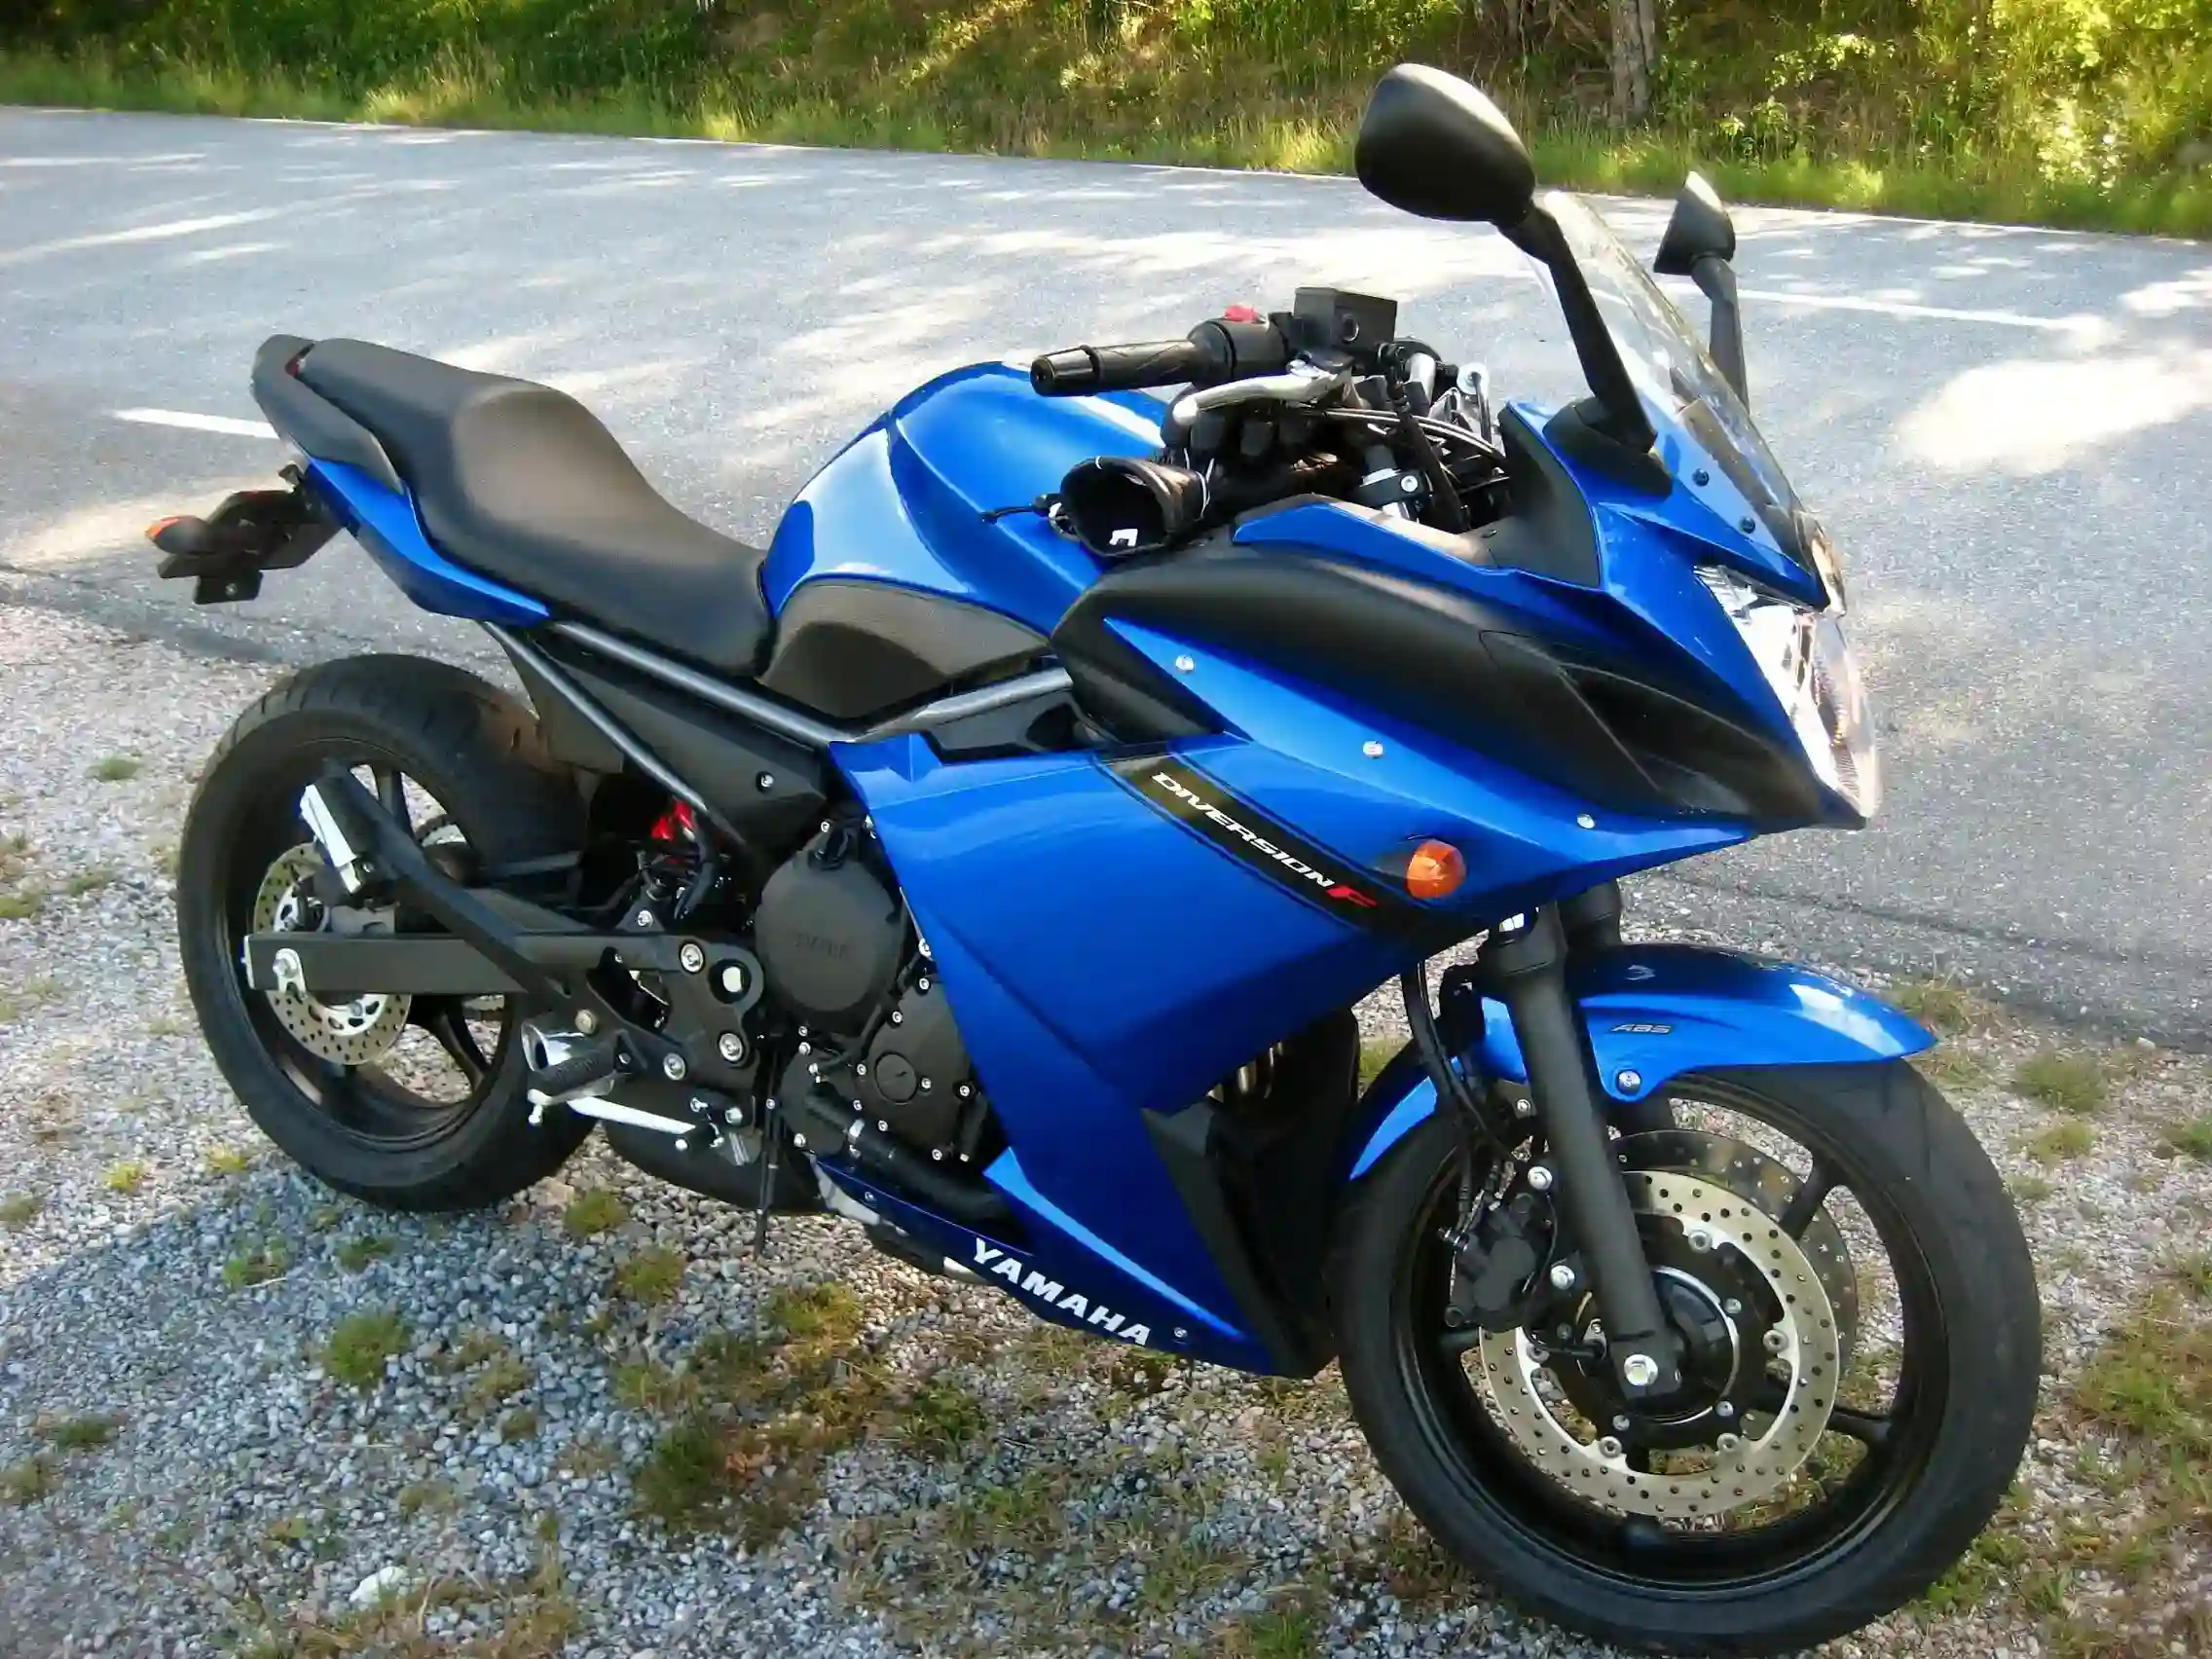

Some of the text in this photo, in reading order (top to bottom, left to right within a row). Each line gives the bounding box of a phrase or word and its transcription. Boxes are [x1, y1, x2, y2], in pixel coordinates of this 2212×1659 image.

[1152, 772, 1335, 887] DIVERSION
[1610, 1023, 1672, 1034] ABS
[974, 1237, 1151, 1346] YAMAHA
